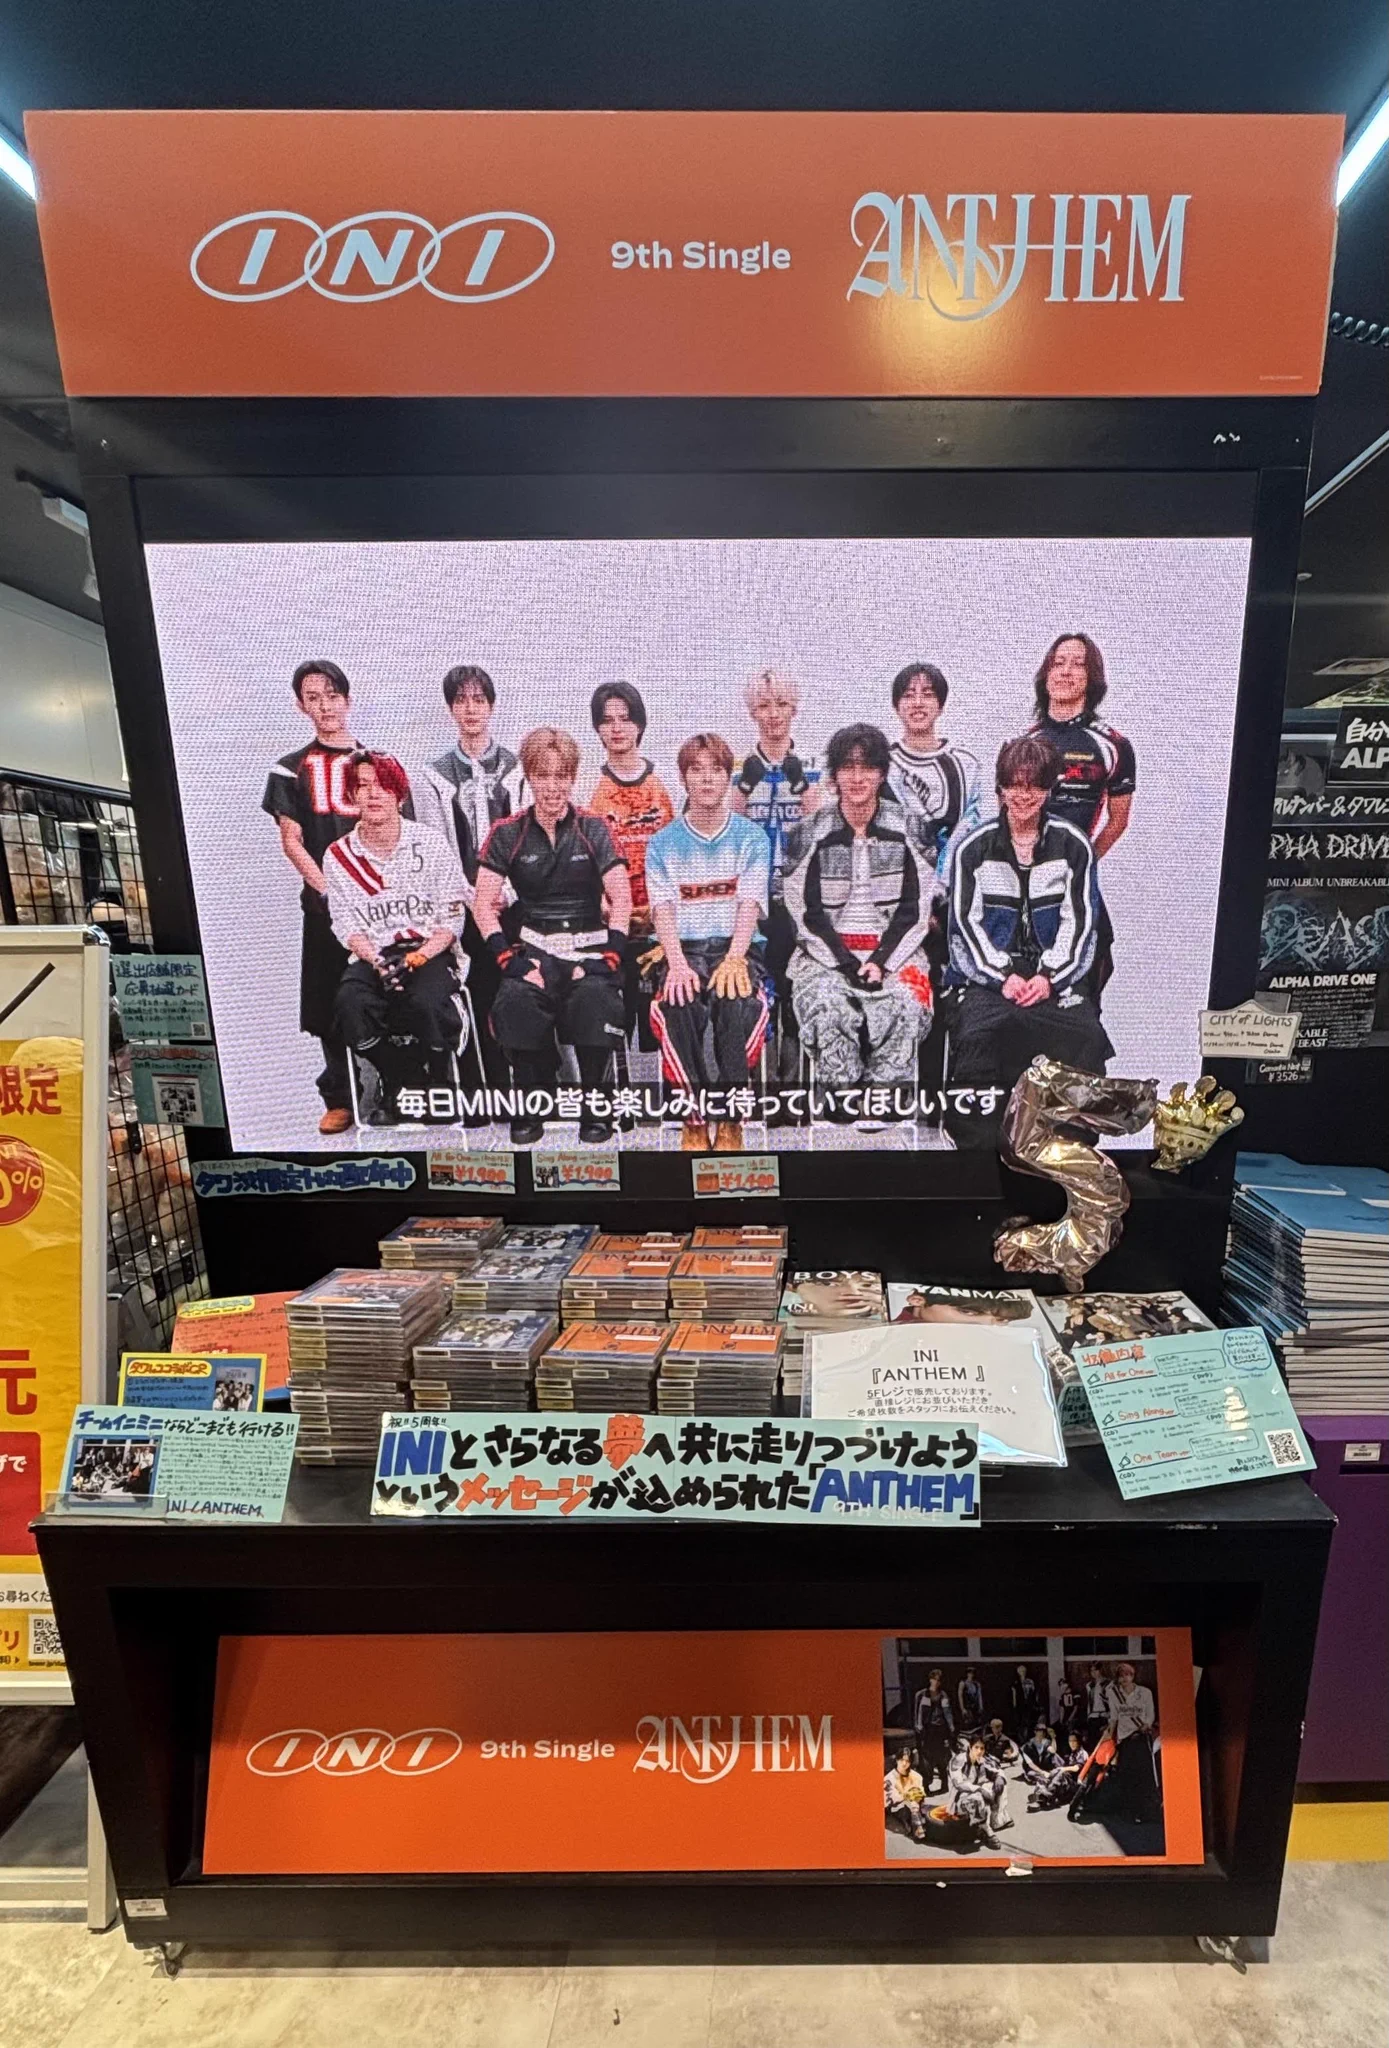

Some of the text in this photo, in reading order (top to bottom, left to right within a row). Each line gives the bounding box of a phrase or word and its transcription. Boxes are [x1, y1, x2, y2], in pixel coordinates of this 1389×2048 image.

[611, 240, 791, 275] 9th Single
[847, 193, 1191, 322] ANTHEM
[1267, 878, 1289, 887] MINI
[1291, 878, 1323, 887] ALBUM
[1269, 973, 1377, 989] ALPHA DRIVE ONE
[1210, 1014, 1293, 1027] CITY of LIGHTS
[396, 1086, 1005, 1118] 毎日MINIの皆も楽しみに待っていてほしいです
[794, 1270, 876, 1282] BOYS
[914, 1350, 939, 1362] INI
[1104, 1371, 1115, 1380] All
[1128, 1368, 1145, 1377] One
[867, 1386, 992, 1400] 5Fレジで販売しております。
[874, 1397, 989, 1407] 直接レジにお並びいただき
[847, 1405, 1017, 1418] ご希望枚数をスタッフにお伝えください。
[1118, 1410, 1139, 1421] Sing
[379, 1414, 977, 1478] INIとさらなる夢へ共に走りつづけよう
[1133, 1453, 1152, 1464] One
[1157, 1450, 1177, 1459] Team
[480, 1740, 615, 1763] 9th Single
[632, 1715, 835, 1785] ANTHEM
